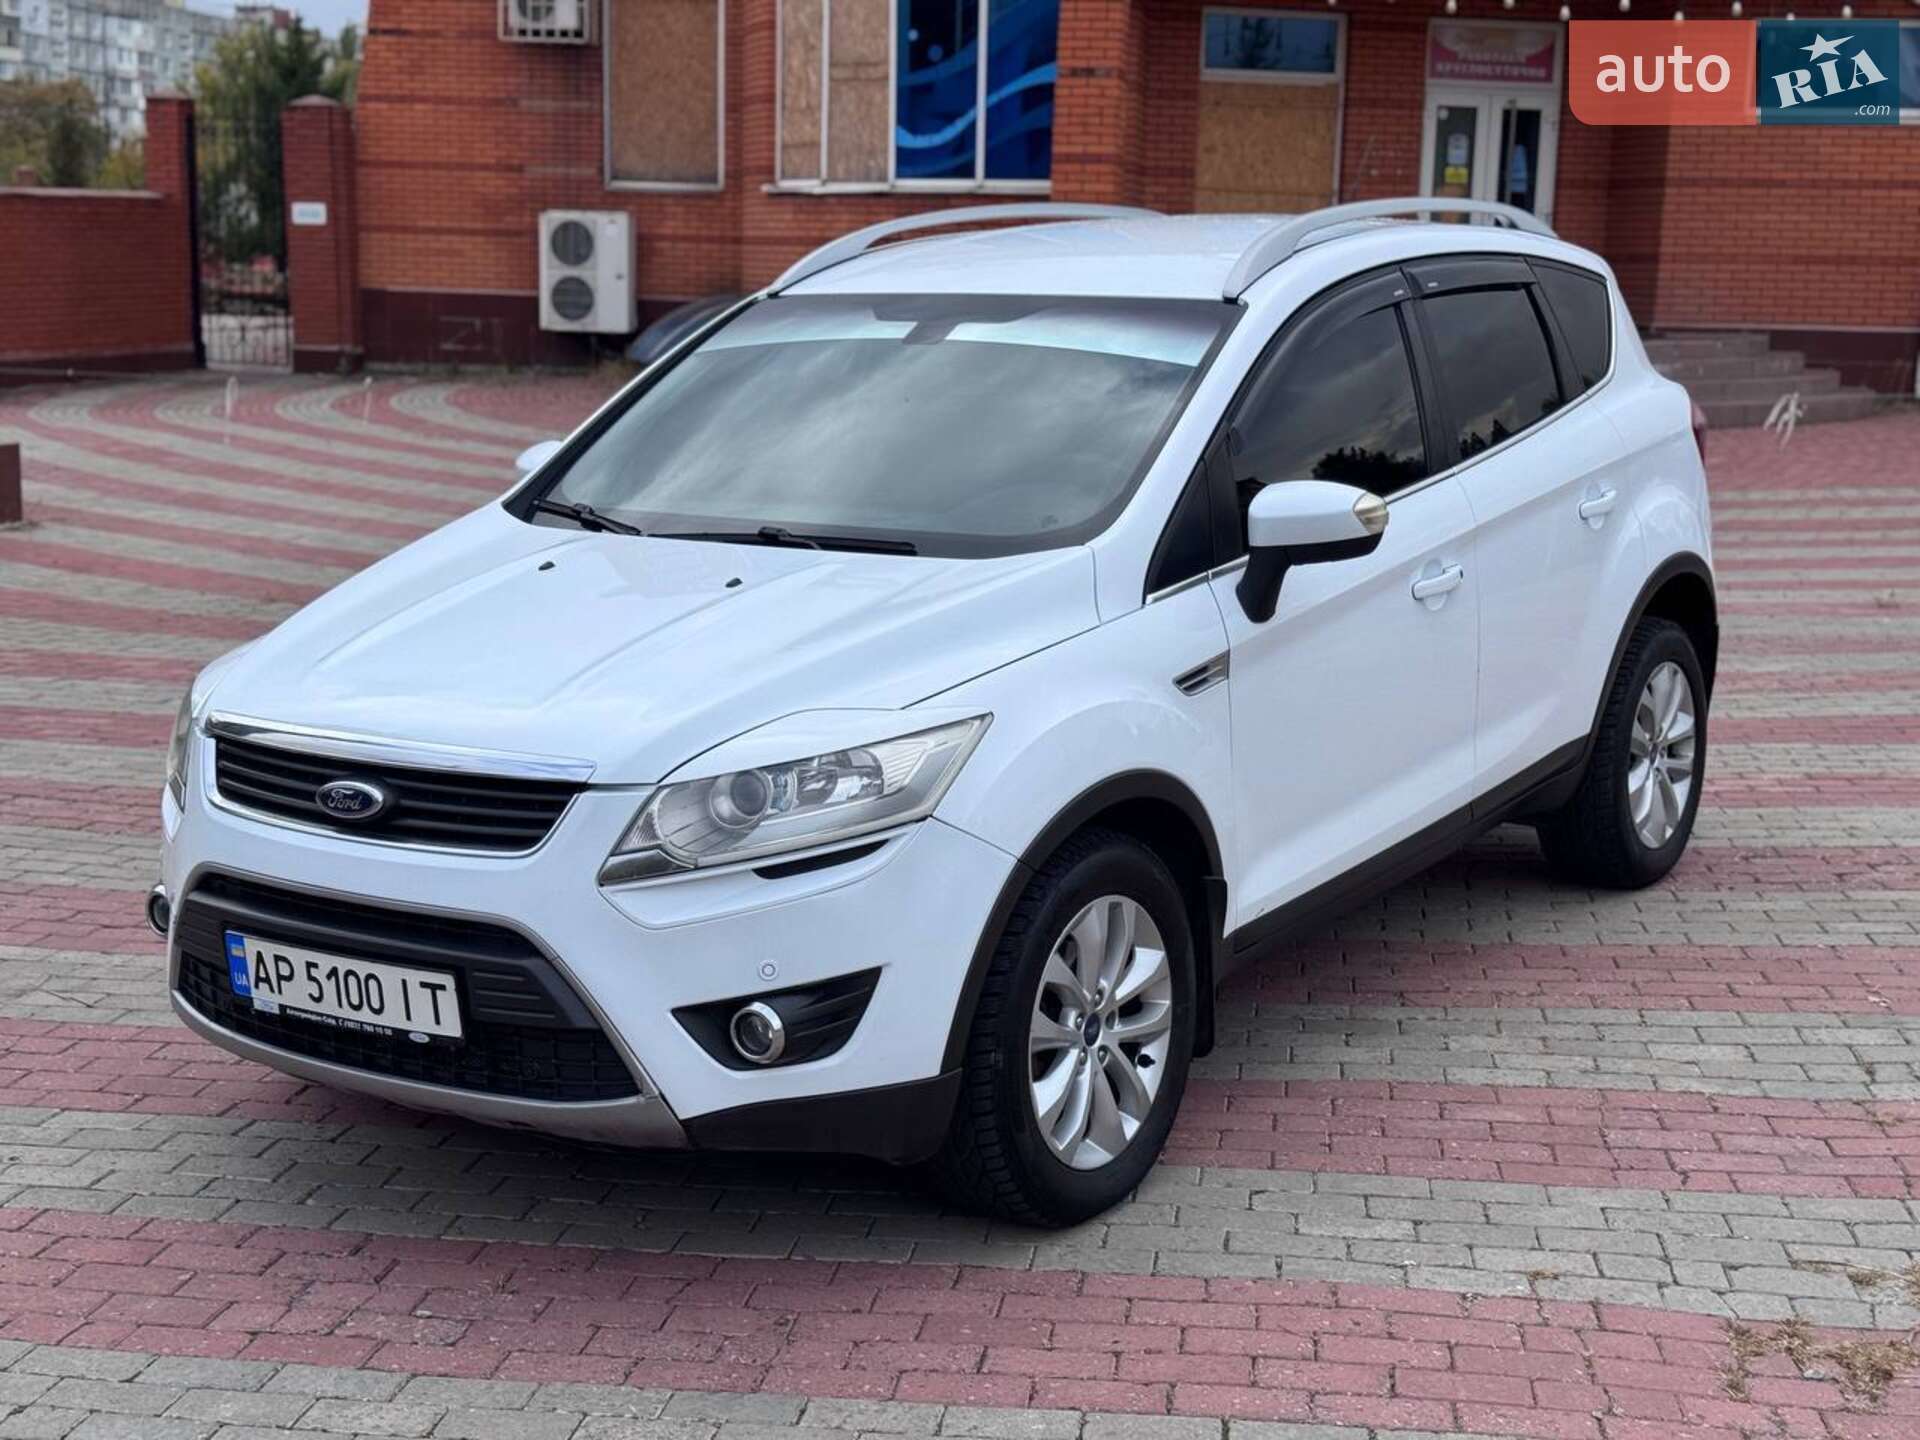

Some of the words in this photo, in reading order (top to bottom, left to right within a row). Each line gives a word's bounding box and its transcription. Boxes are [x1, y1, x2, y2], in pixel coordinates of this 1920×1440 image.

[327, 788, 363, 810] Ford
[233, 971, 249, 987] UA
[254, 950, 295, 996] AP
[305, 960, 385, 1016] 5100
[401, 978, 447, 1027] IT
